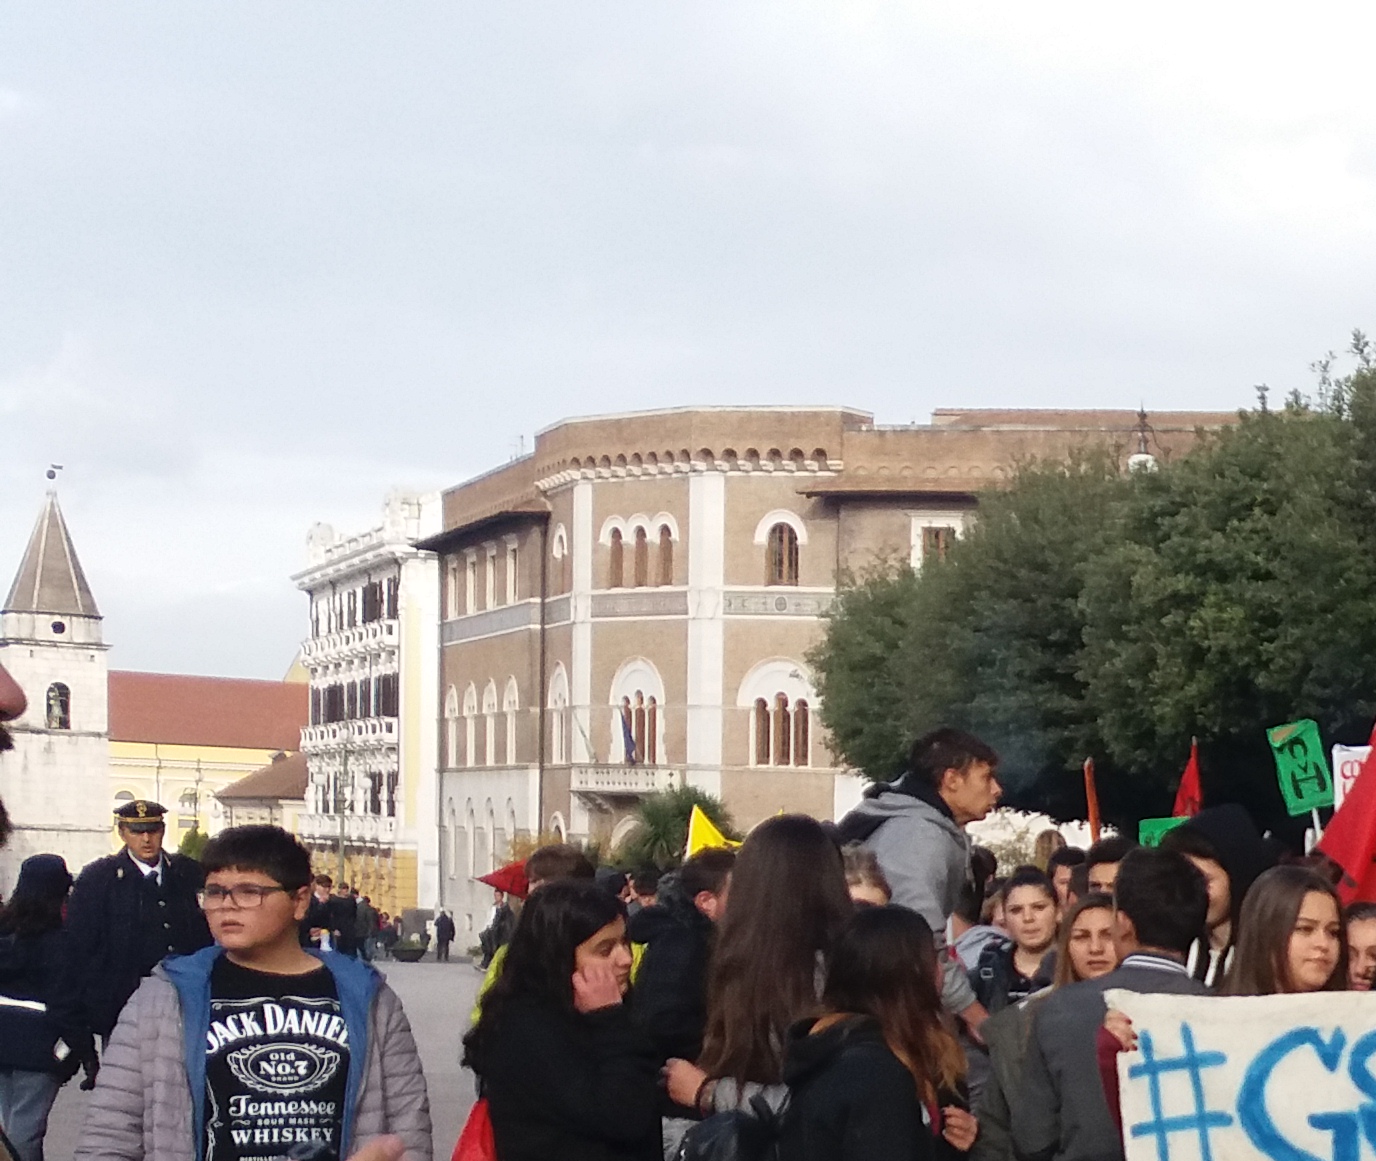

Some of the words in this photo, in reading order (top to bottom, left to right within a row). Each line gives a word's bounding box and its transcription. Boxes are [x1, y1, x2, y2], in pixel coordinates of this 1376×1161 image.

[206, 1012, 260, 1053] JACK
[269, 1052, 296, 1061] Old
[258, 1060, 309, 1076] No.7
[228, 1095, 337, 1117] Tennessee
[256, 1117, 286, 1126] SOUR
[288, 1117, 316, 1125] MASH
[230, 1127, 334, 1145] WHISKEY
